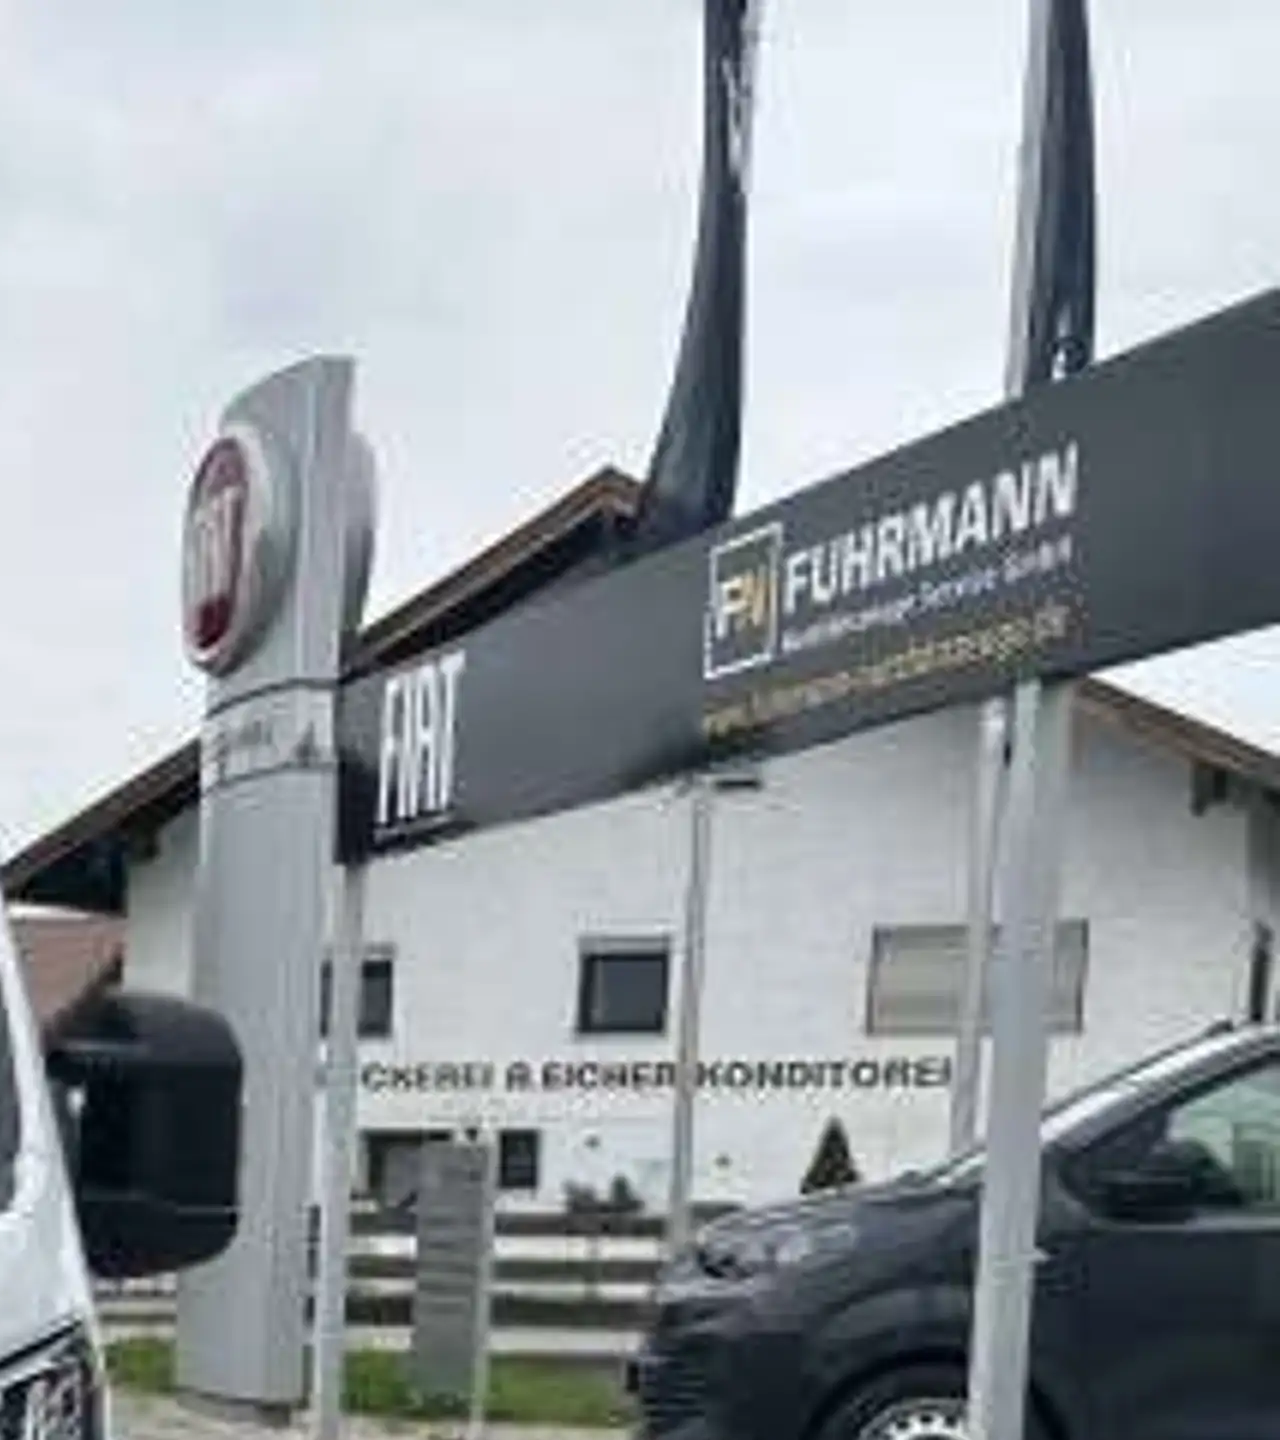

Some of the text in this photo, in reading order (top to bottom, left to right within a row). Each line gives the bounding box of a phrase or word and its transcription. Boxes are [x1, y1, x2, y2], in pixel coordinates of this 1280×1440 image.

[782, 438, 1078, 615] FUHRMANN
[377, 648, 466, 824] FIAT
[696, 1056, 952, 1089] KONDITOREI
